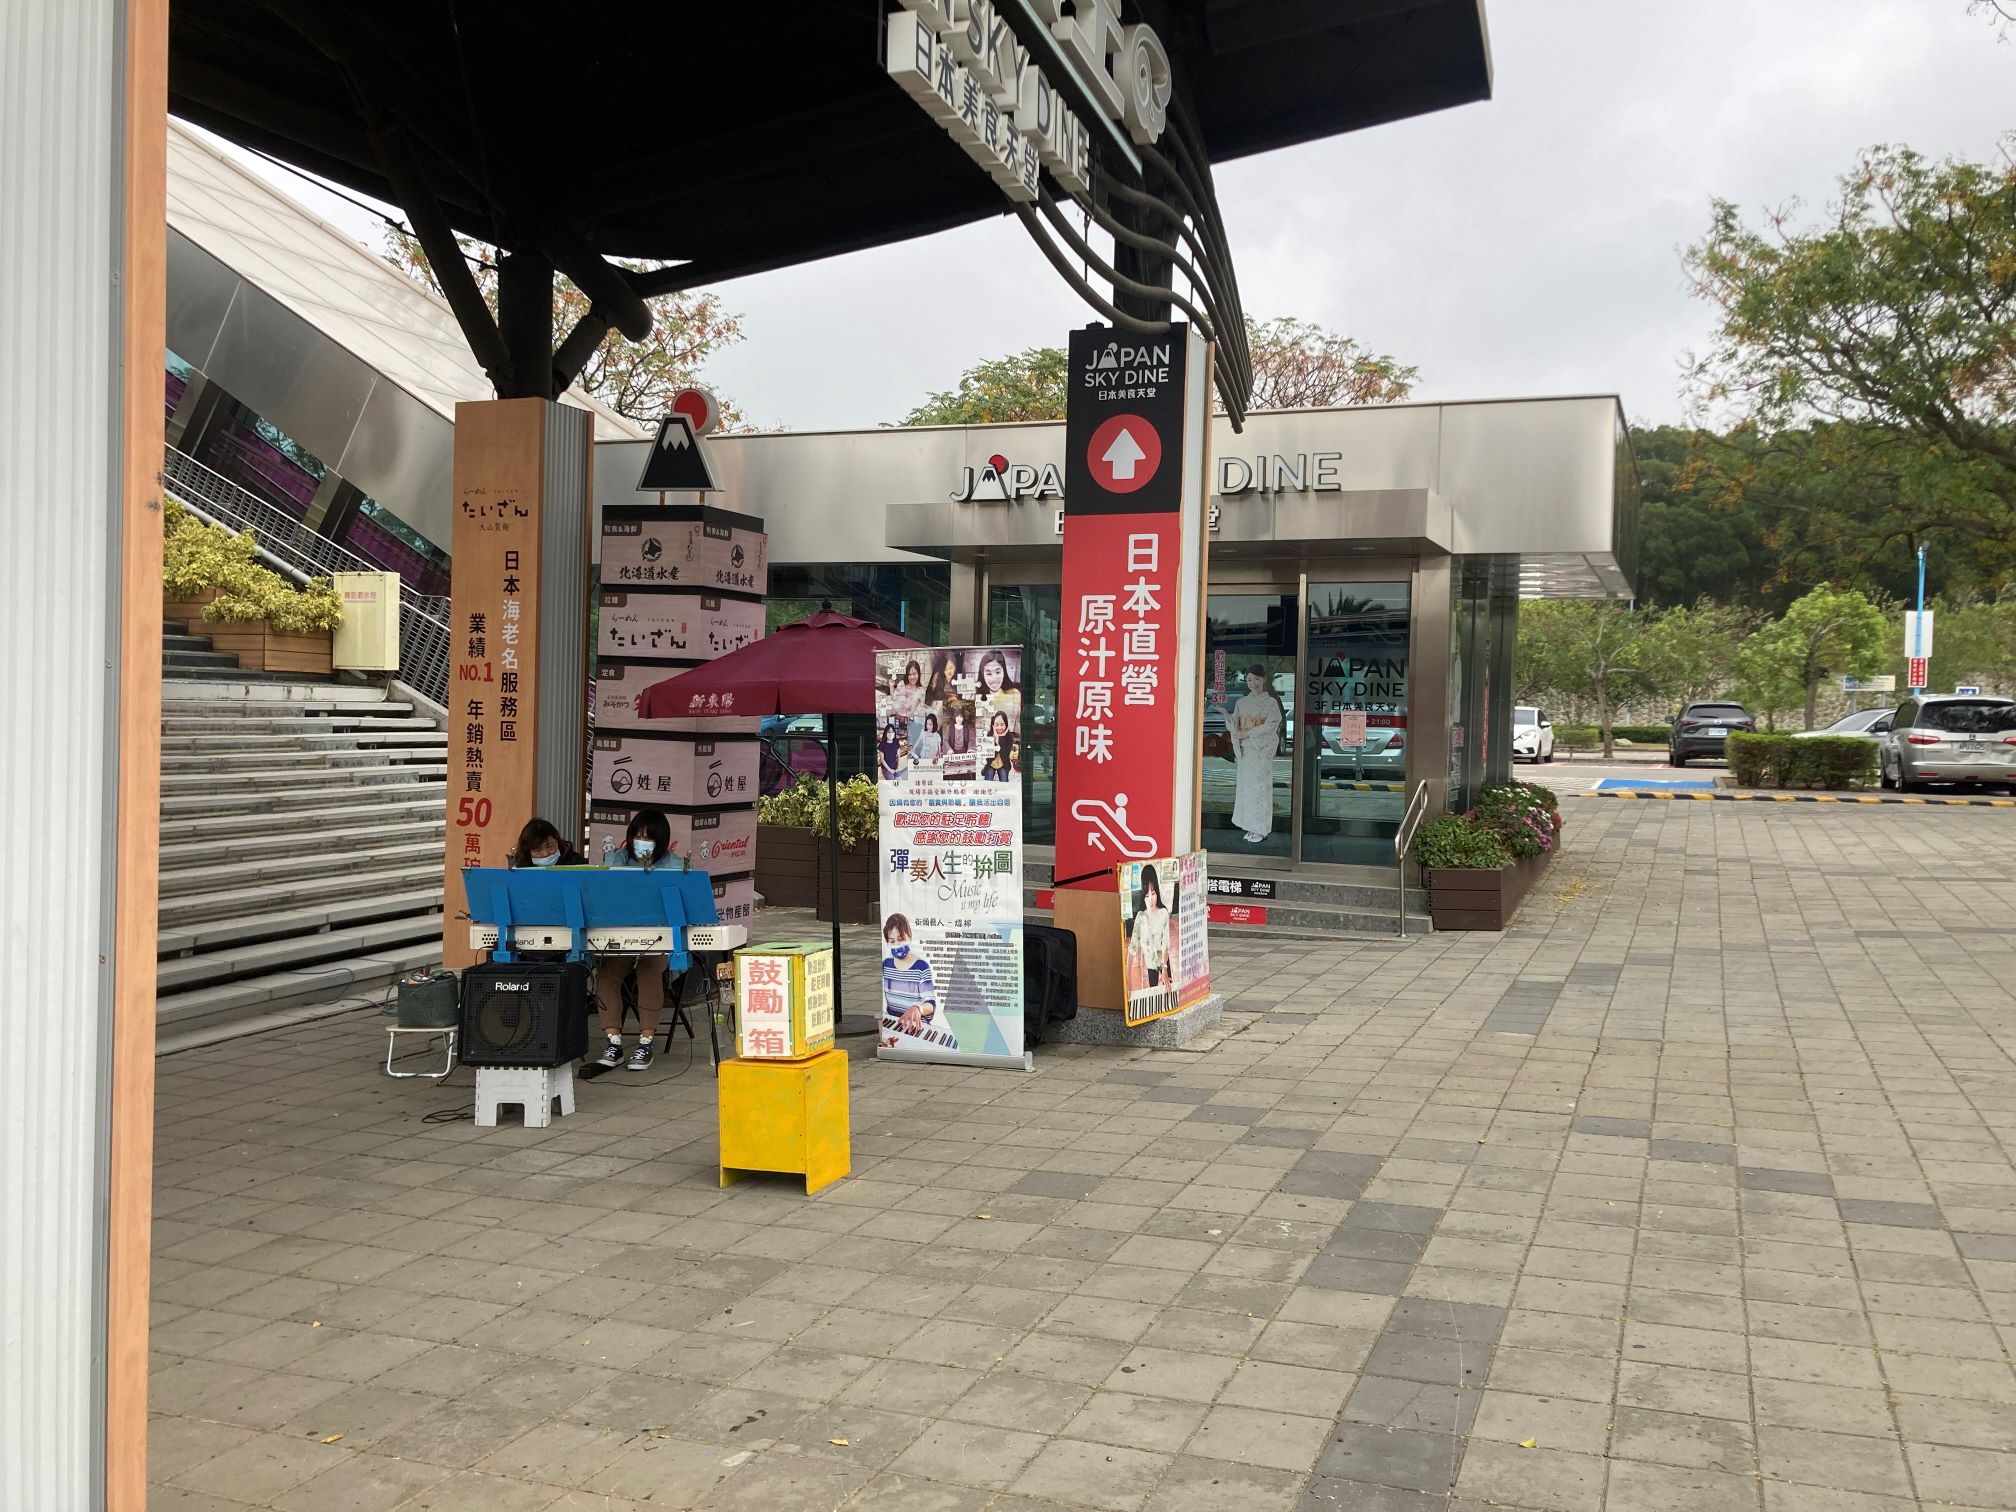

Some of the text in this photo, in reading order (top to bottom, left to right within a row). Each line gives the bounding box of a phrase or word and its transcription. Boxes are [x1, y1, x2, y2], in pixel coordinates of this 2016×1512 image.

[914, 18, 1040, 198] 日本美食天堂
[1037, 67, 1090, 191] DINE
[1085, 342, 1170, 371] JAPAN
[1085, 367, 1170, 388] SKY DINE
[1097, 386, 1157, 402] 日本美食天堂
[949, 452, 1342, 502] JAPA DINE
[462, 499, 529, 519] たいざん
[1120, 532, 1161, 707] 日本直營
[499, 549, 522, 743] 日本海老名服務區
[609, 627, 687, 649] たいざん
[708, 631, 751, 651] たいざ
[1309, 655, 1405, 678] JAPAN
[1074, 593, 1117, 765] 原汁原味
[1308, 681, 1405, 697] SKY DINE
[1314, 701, 1398, 712] 3F 日本美食天堂
[711, 835, 751, 858] Oriental
[937, 880, 983, 902] Music
[983, 891, 999, 914] life
[495, 981, 530, 992] Roland
[747, 959, 784, 1055] 鼓勵箱
